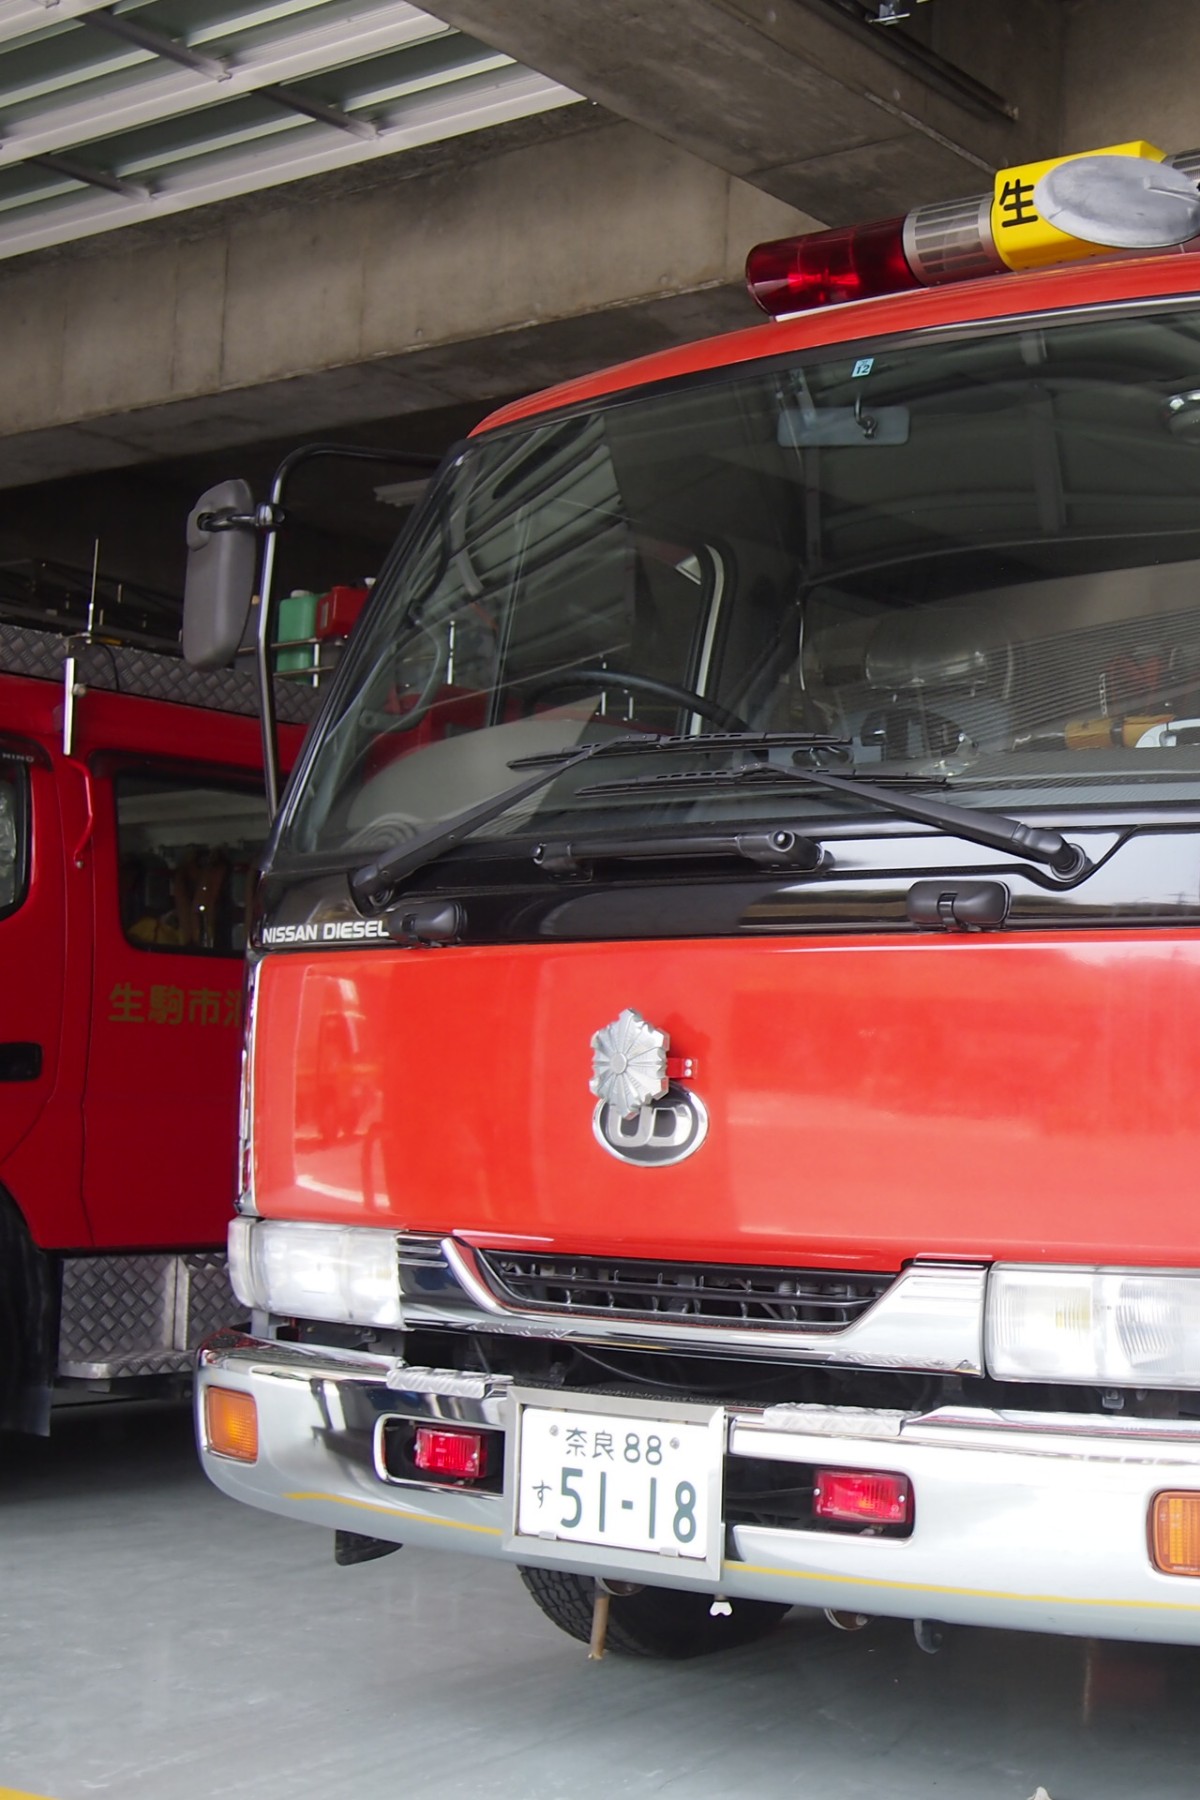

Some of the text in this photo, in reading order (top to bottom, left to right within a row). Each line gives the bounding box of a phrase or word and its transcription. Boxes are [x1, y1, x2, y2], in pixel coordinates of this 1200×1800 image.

[999, 178, 1039, 228] 生
[2, 752, 35, 763] HINO
[262, 920, 390, 944] NISSAN DIESEL
[565, 1426, 662, 1466] 奈良 88
[531, 1466, 697, 1543] す 51-18
